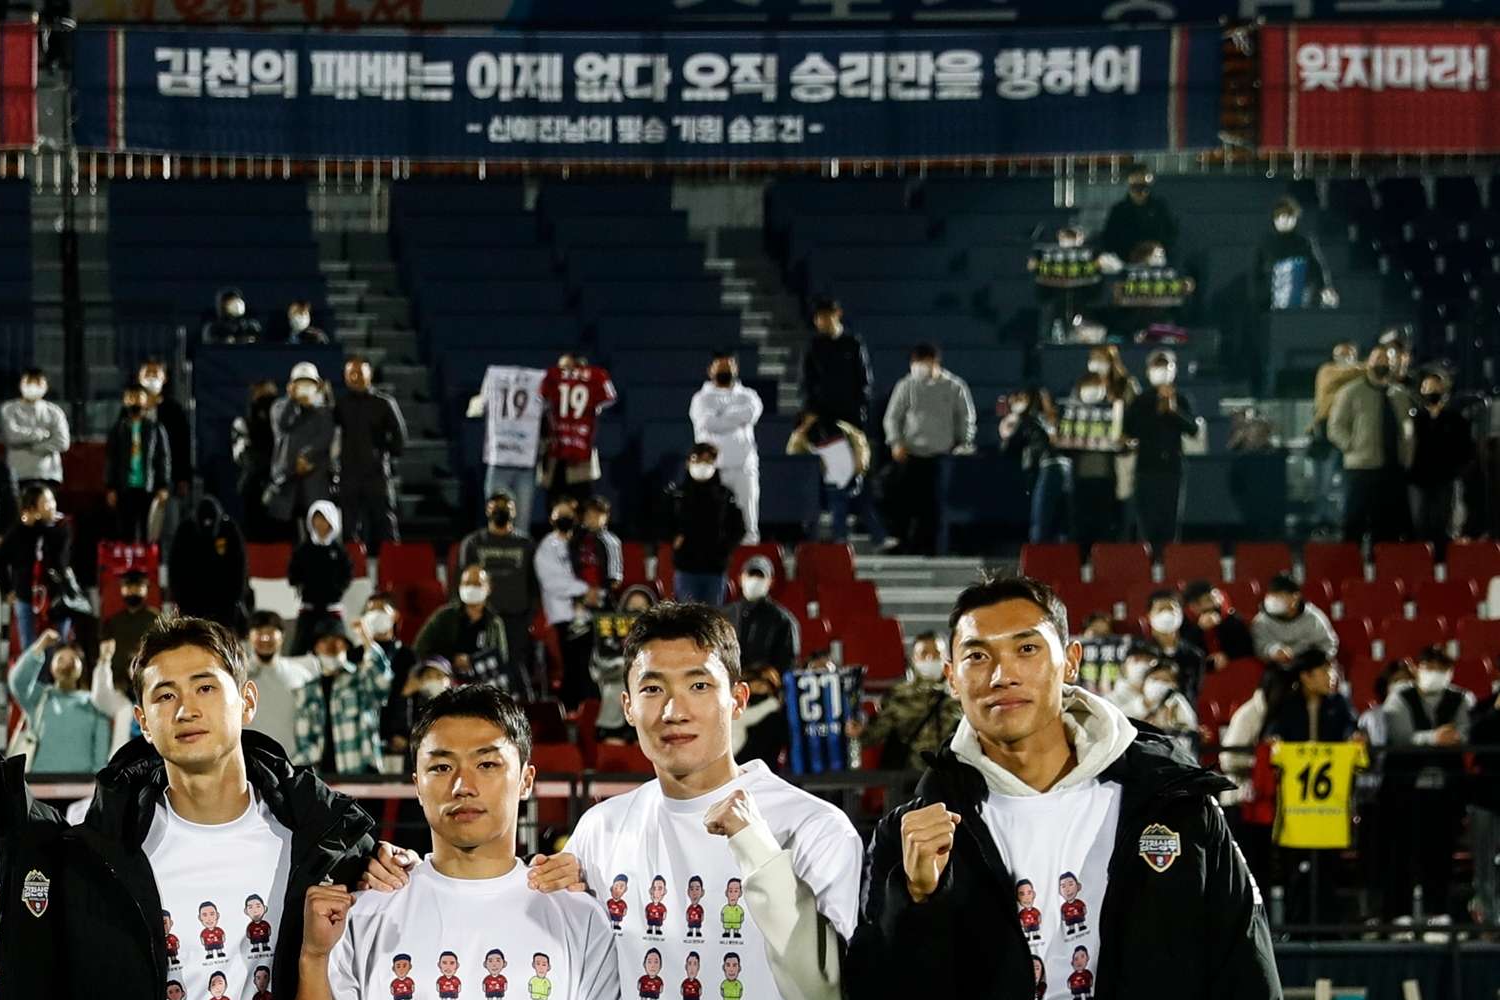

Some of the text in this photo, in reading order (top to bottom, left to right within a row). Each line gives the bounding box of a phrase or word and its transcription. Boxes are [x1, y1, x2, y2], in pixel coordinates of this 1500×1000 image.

[155, 46, 1141, 103] 김천의 패배는 이제 없다 오직 승리만을 향하여
[1296, 42, 1487, 92] 잊지마라!
[500, 388, 528, 420] 19
[558, 382, 590, 420] 19
[798, 672, 842, 721] 27
[1298, 762, 1332, 801] 16
